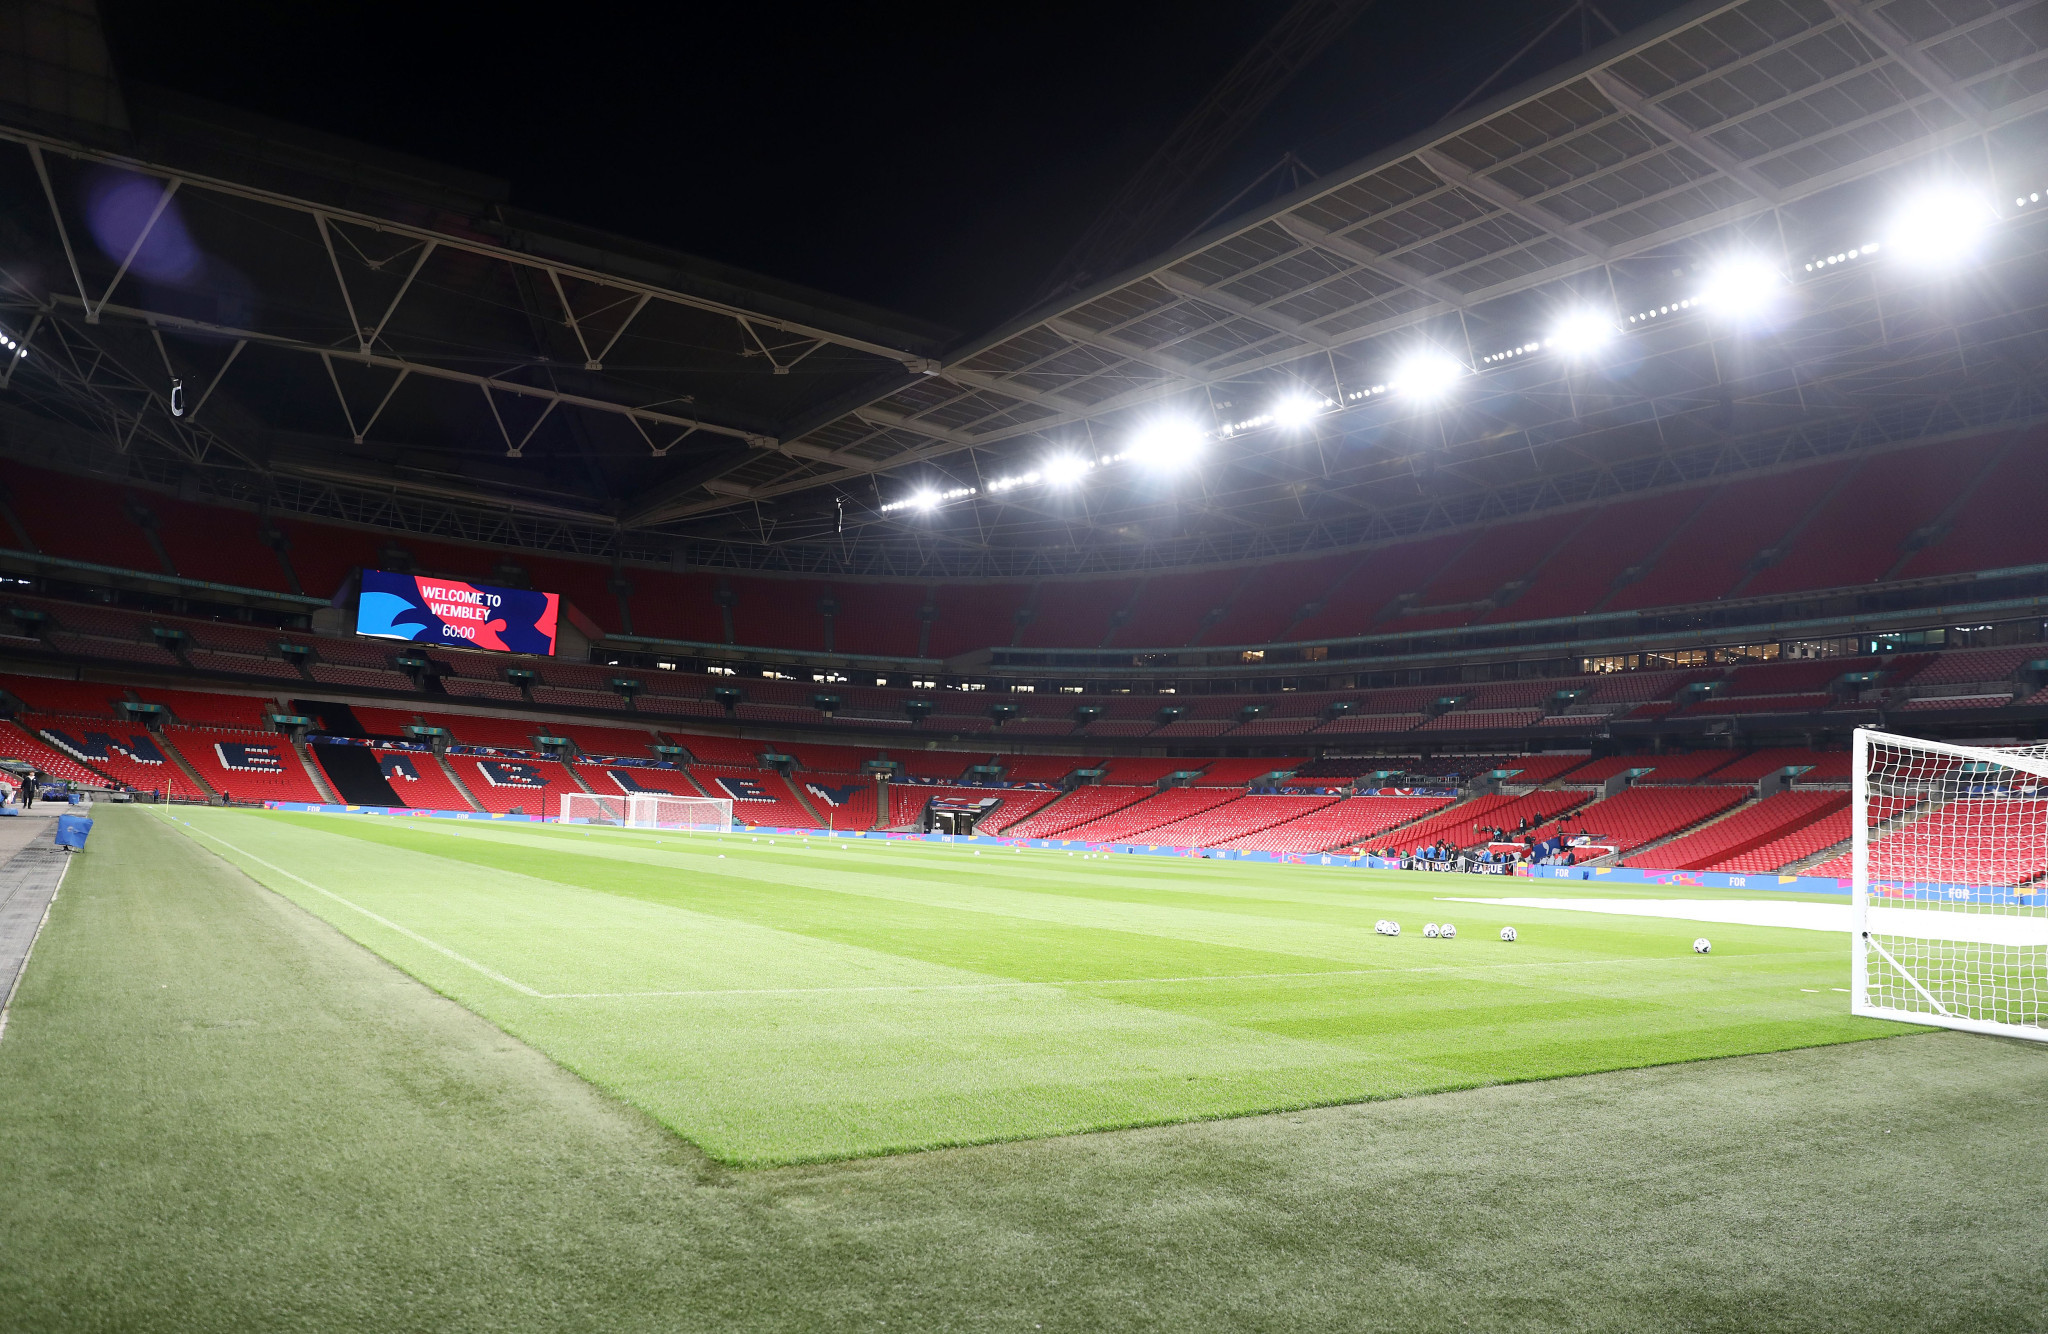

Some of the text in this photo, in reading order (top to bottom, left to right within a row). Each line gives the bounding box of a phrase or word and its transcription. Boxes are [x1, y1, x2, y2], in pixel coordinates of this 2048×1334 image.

[422, 585, 502, 608] WELCOME TO
[430, 602, 492, 622] WEMBLEY
[442, 624, 475, 639] 60:00
[1555, 868, 1569, 878] FOR
[1729, 877, 1746, 887] FOR
[1948, 887, 1970, 899] FOR
